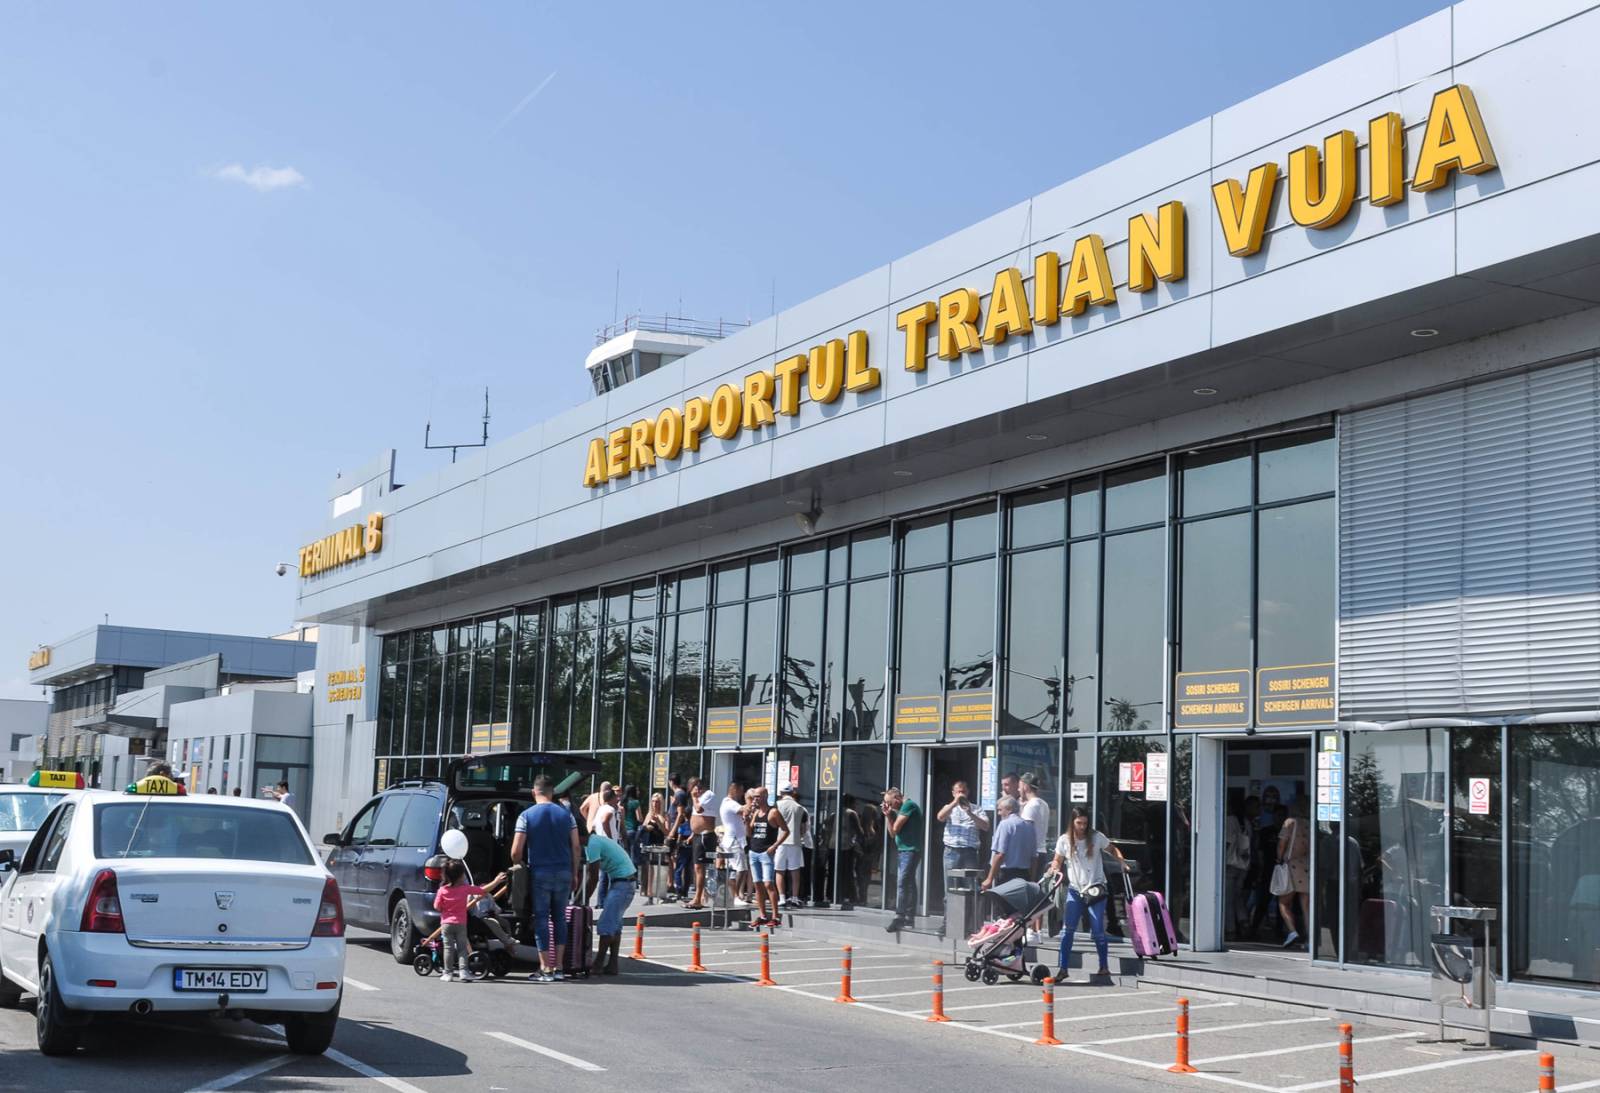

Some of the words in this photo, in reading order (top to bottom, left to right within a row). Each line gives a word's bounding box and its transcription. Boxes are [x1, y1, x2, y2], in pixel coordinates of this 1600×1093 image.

[583, 330, 880, 488] AEROPORTUL
[896, 200, 1185, 373] TRAIAN
[1212, 83, 1498, 258] VUIA
[299, 524, 366, 577] TERMINAL
[367, 512, 383, 553] B
[1206, 682, 1240, 694] SCHENGEN
[1291, 676, 1329, 690] SCHENGEN
[1181, 703, 1213, 715] SCHENGEN
[1214, 702, 1245, 714] ARRIVALS
[1263, 700, 1300, 712] SCHENGEN
[1300, 697, 1334, 710] ARRIVALS
[50, 773, 66, 781] TAXI
[145, 779, 169, 794] TAXI
[230, 972, 263, 987] EDY
